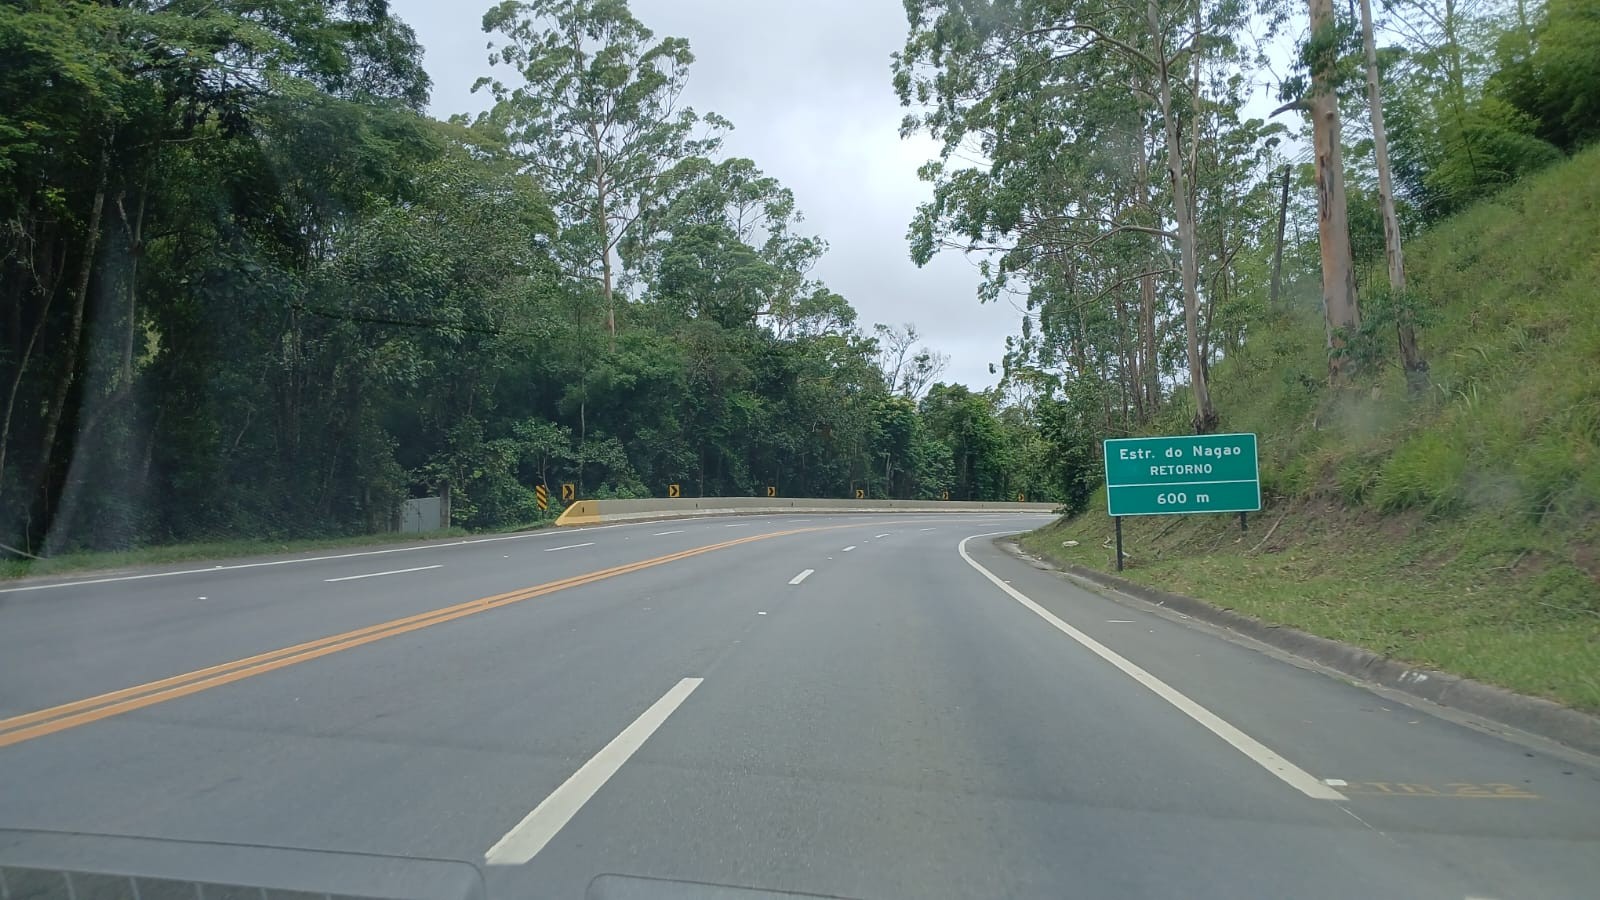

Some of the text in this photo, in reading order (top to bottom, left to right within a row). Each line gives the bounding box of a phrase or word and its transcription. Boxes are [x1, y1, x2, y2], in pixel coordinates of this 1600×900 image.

[1120, 445, 1241, 460] Estr. do Nagao
[1150, 464, 1212, 476] RETORNO
[1157, 493, 1210, 505] 600 m
